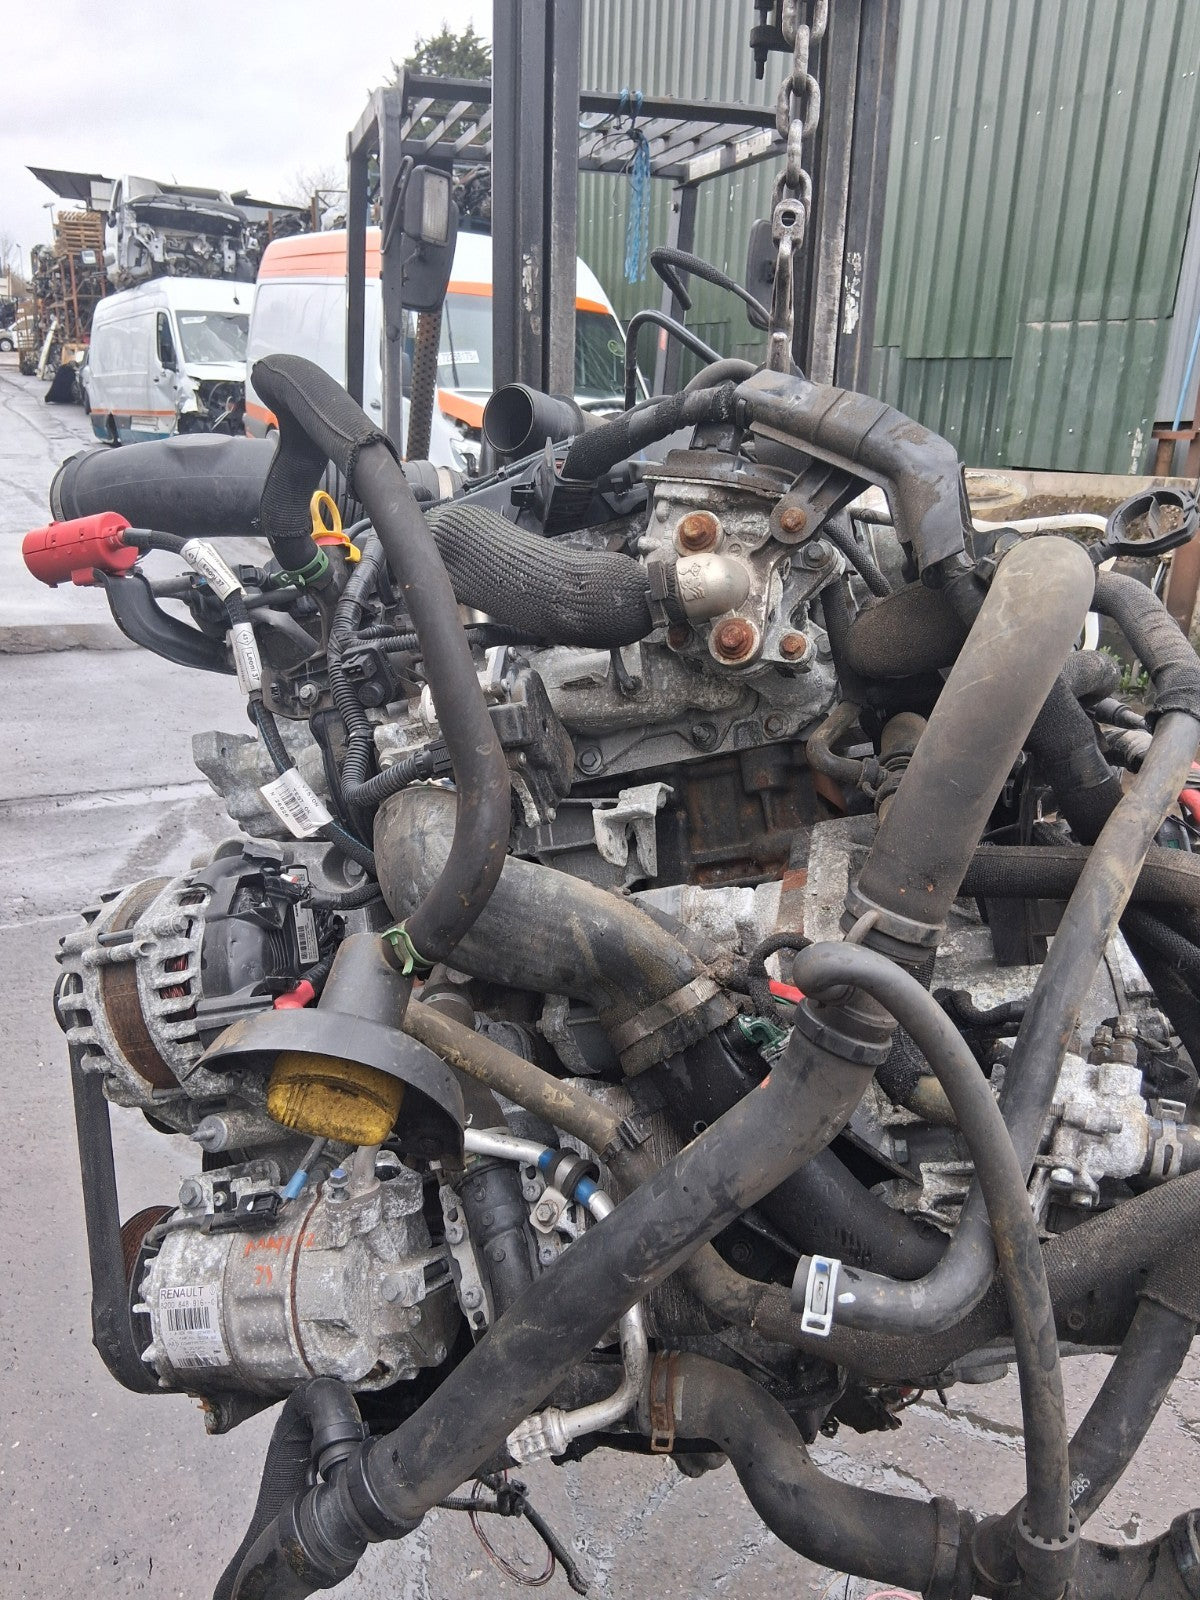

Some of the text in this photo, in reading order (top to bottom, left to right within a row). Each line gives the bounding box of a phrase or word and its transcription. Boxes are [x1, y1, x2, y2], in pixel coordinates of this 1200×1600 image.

[202, 562, 217, 580] Leoni
[246, 651, 260, 681] Leoni 37
[160, 1286, 204, 1300] RENAULT
